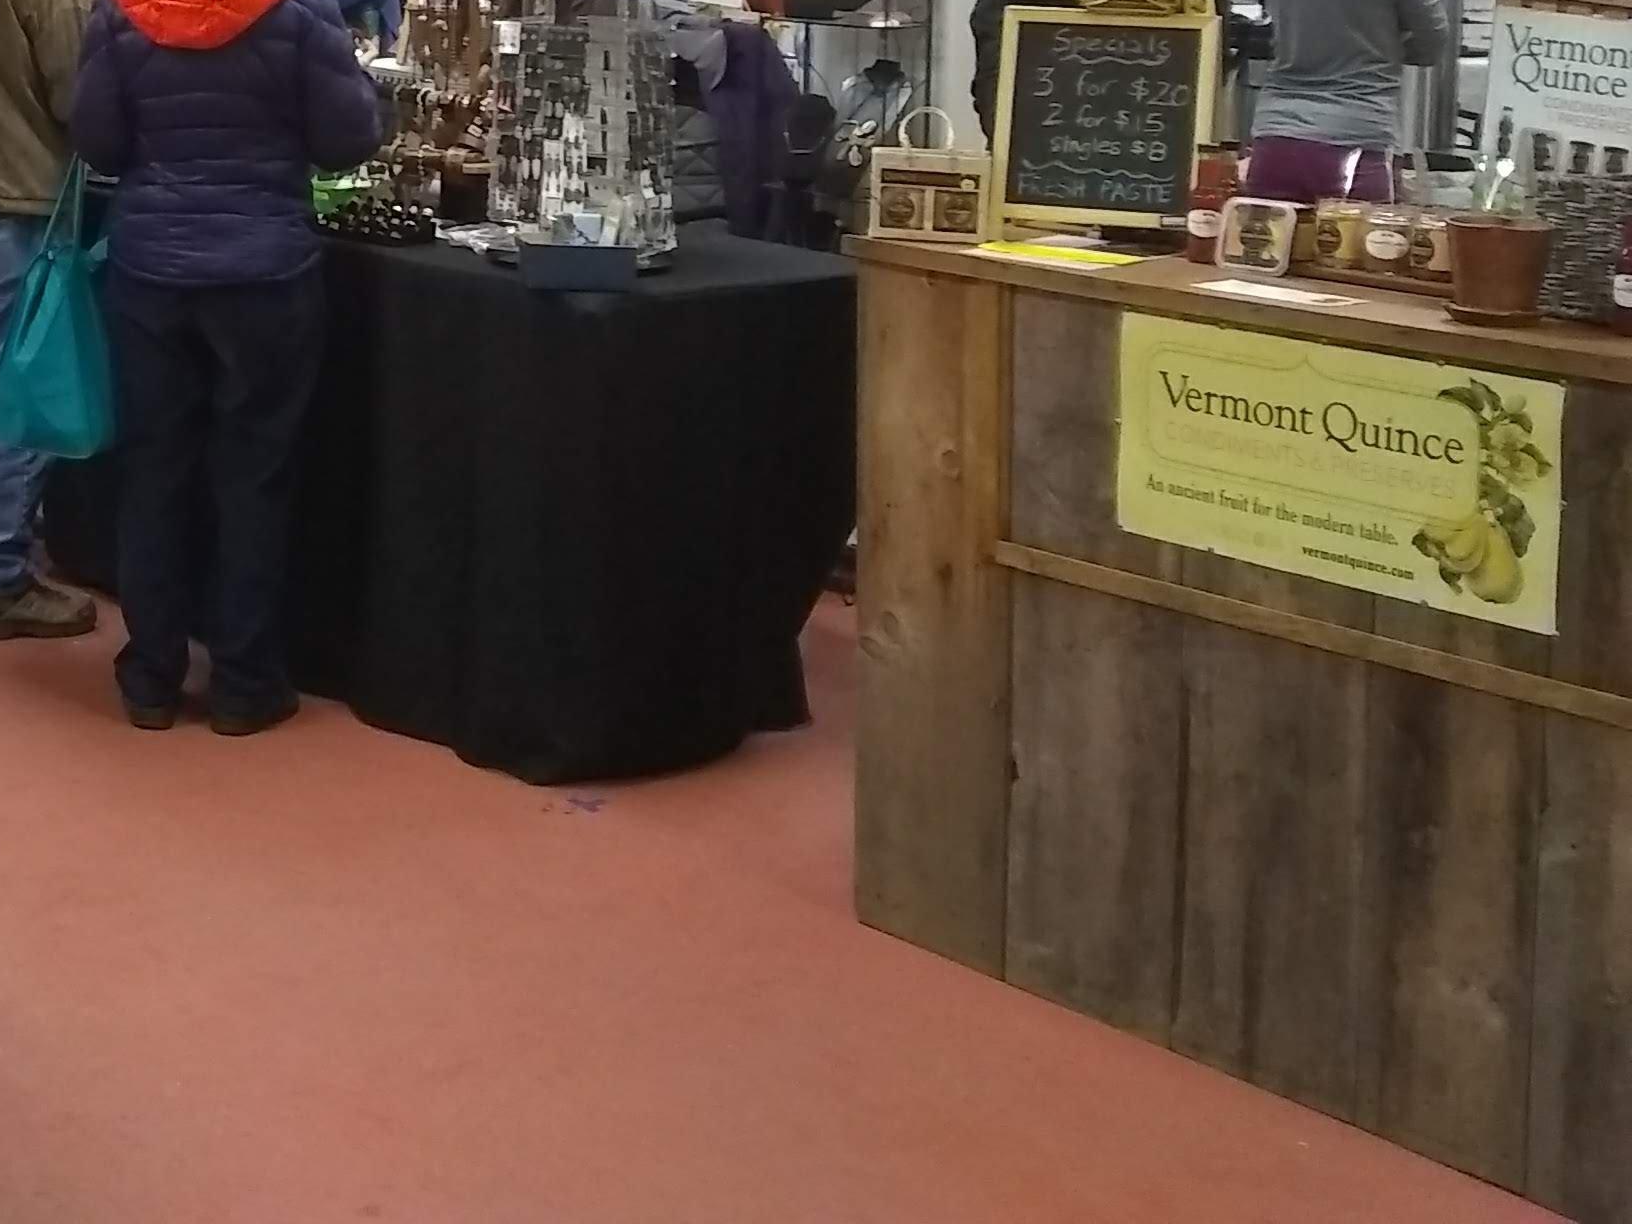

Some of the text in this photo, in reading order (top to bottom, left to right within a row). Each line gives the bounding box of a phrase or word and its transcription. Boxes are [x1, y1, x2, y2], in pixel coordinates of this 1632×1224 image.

[1052, 28, 1172, 58] Specials
[1033, 66, 1191, 107] 3 for $20
[1511, 52, 1629, 99] Quince
[1040, 102, 1166, 134] 2 for $15
[1049, 135, 1167, 162] singles $8
[1099, 179, 1175, 204] PASTE
[1158, 370, 1466, 465] Vermont Quince
[1145, 473, 1165, 494] An
[1167, 482, 1216, 506] ancient
[1219, 488, 1249, 516] fruit
[1252, 500, 1273, 519] for
[1275, 501, 1299, 526] the
[1302, 513, 1354, 539] modern
